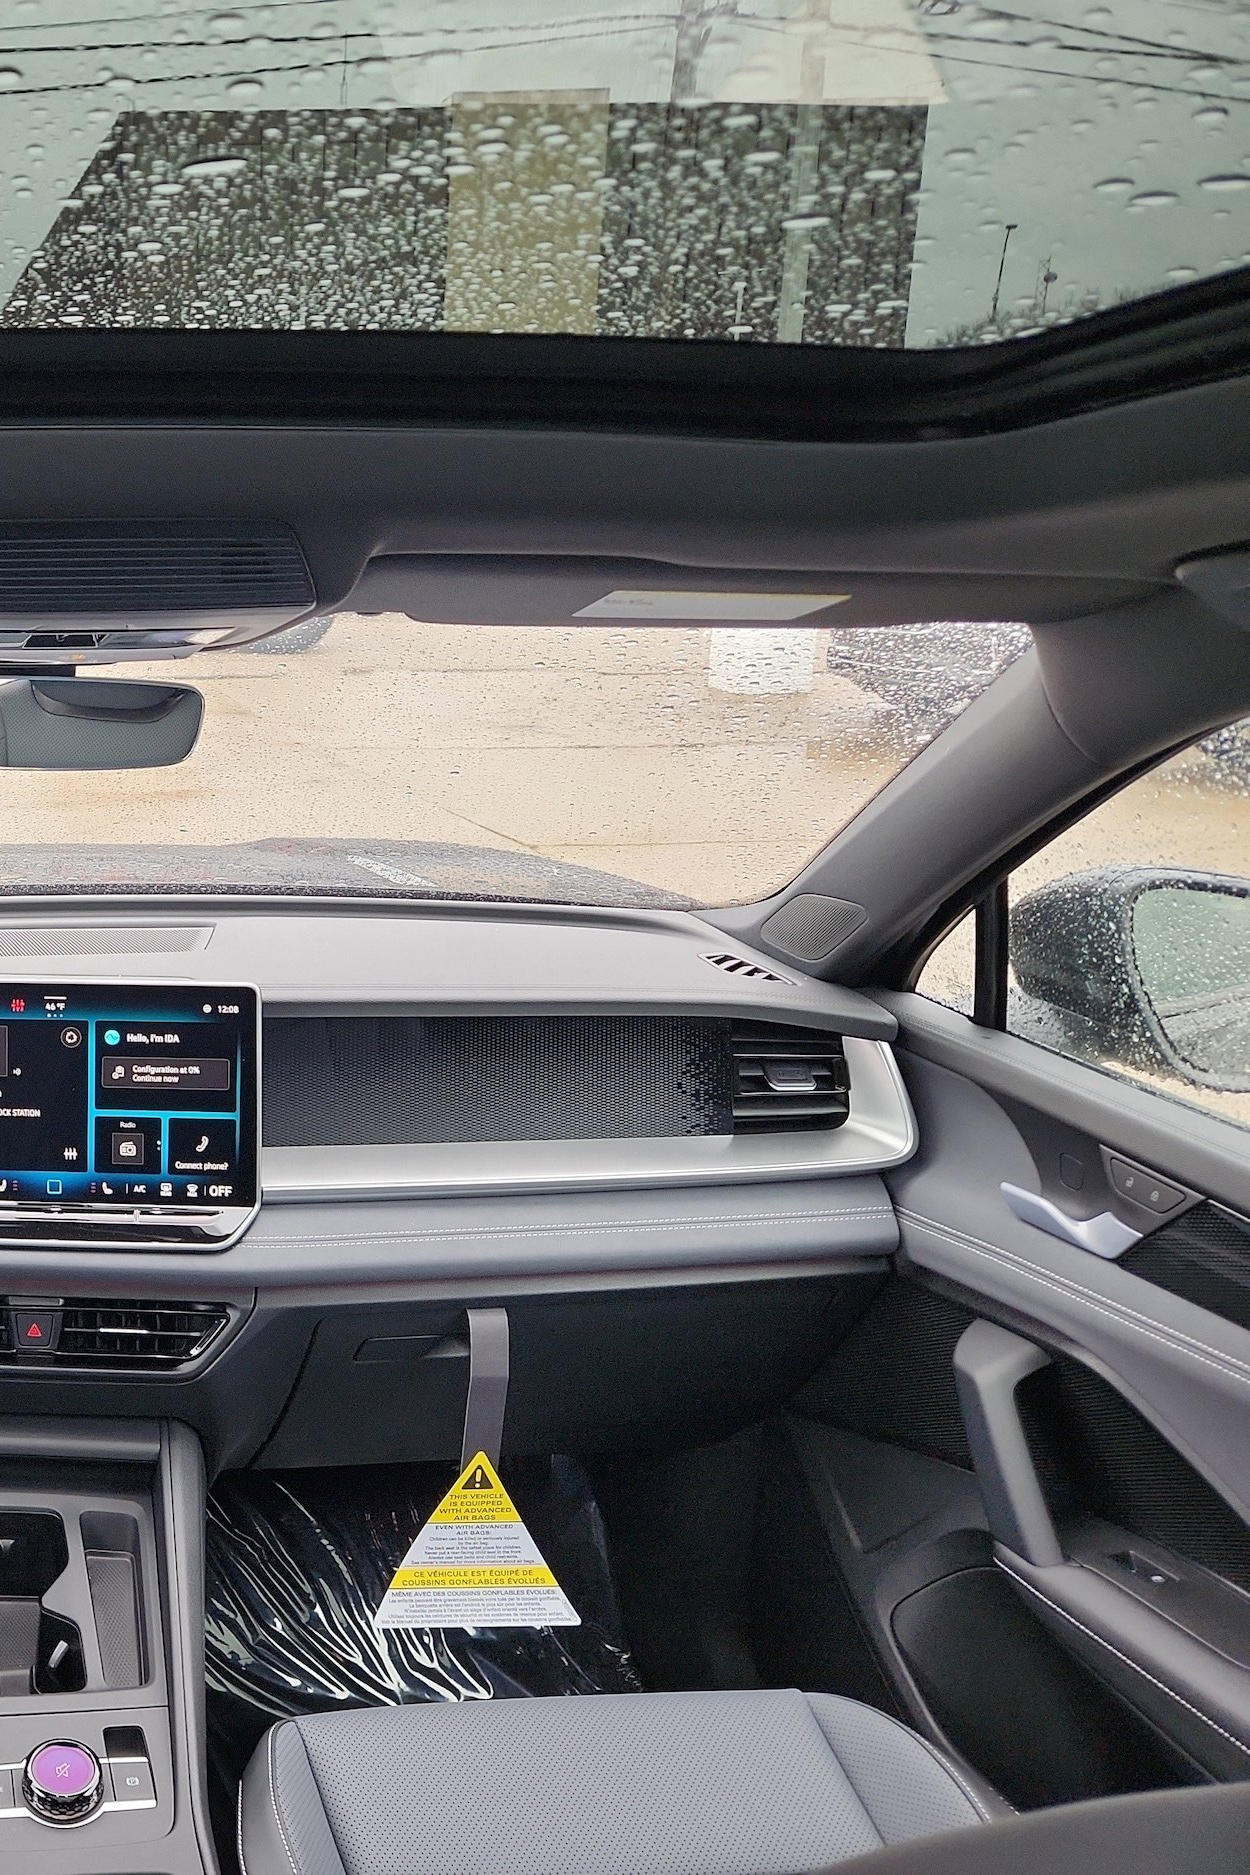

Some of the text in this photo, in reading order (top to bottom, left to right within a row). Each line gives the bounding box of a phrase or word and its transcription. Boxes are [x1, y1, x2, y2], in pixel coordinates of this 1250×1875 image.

[218, 1005, 239, 1013] 12:08
[126, 1033, 149, 1044] Hello,
[165, 1034, 180, 1043] IDA
[132, 1065, 179, 1074] Configuration
[188, 1066, 200, 1074] 0%
[132, 1074, 162, 1082] Continue
[12, 1108, 41, 1117] STATION
[175, 1161, 229, 1171] Connect phone?
[133, 1185, 146, 1193] A/C
[209, 1185, 233, 1197] OFF
